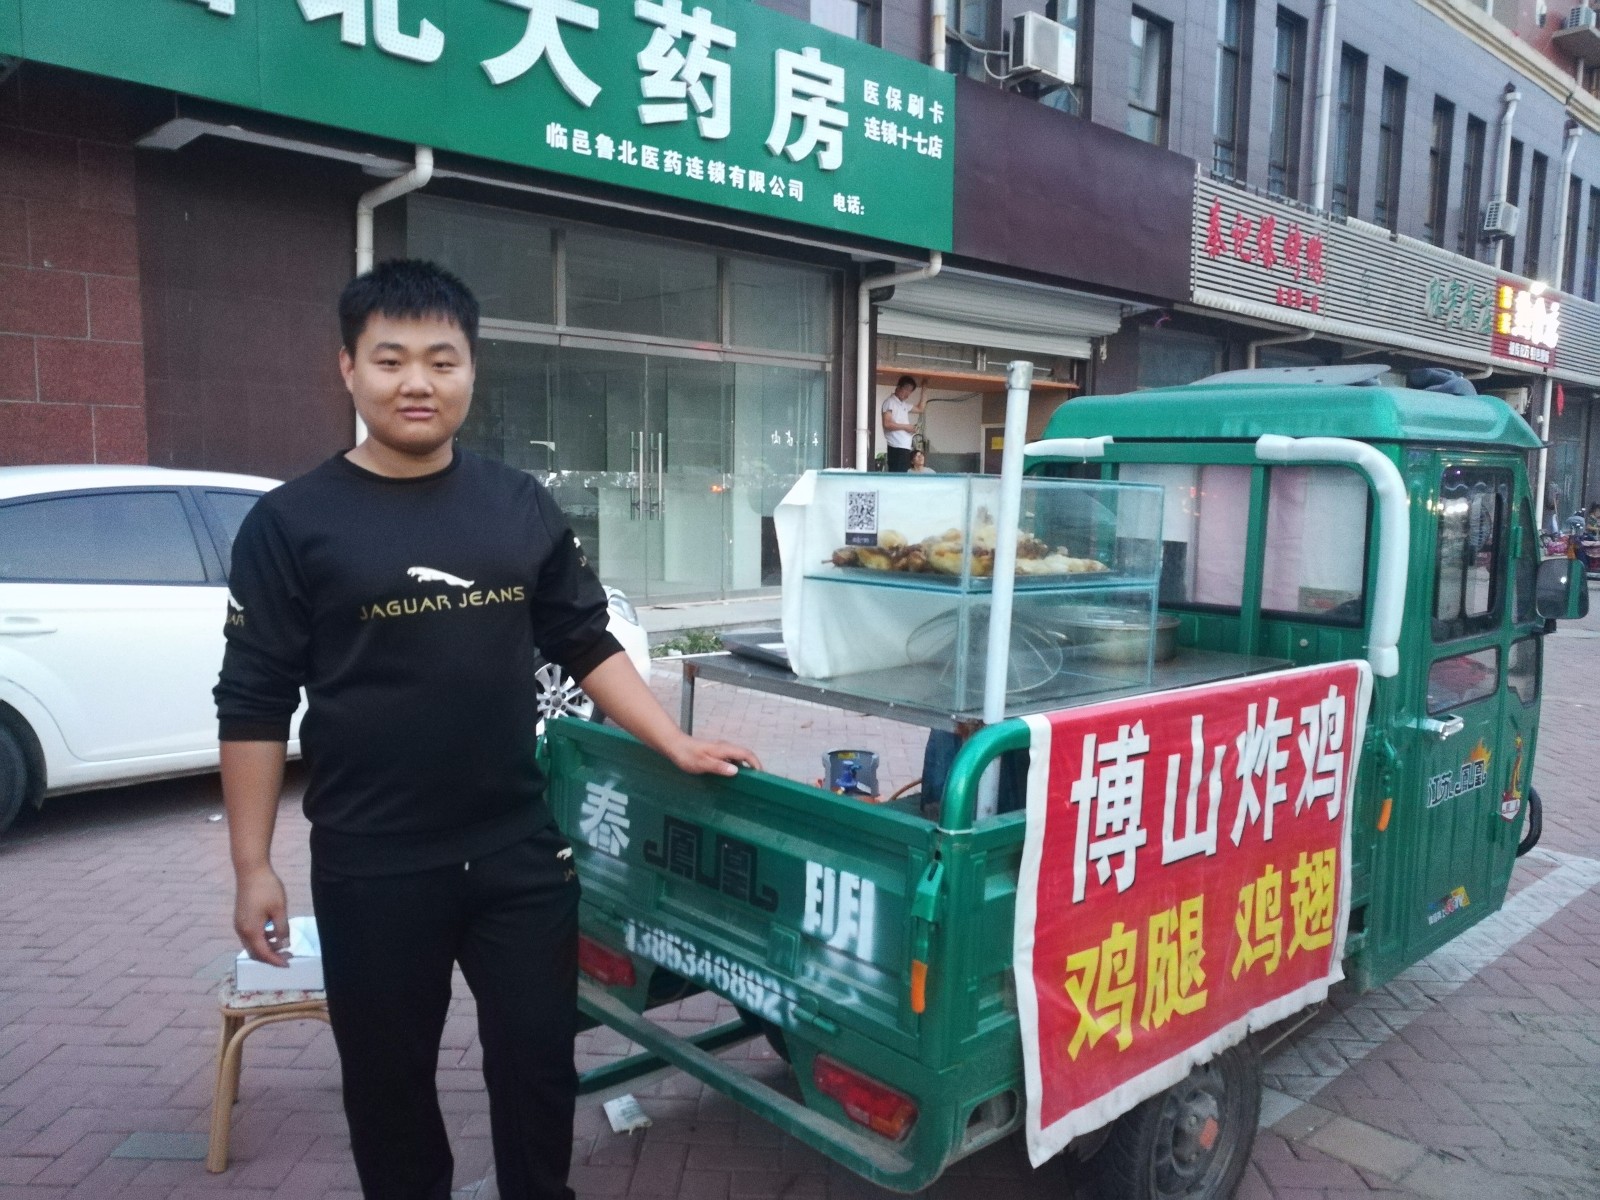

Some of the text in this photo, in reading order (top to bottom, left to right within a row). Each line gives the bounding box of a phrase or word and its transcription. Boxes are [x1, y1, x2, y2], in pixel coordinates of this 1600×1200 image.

[863, 79, 944, 124] 医保刷卡
[863, 116, 943, 160] 连锁十七店
[546, 122, 804, 202] 临邑鲁北医药连锁有限公司
[360, 586, 525, 621] JAGUAR JEANS
[1069, 684, 1347, 903] 博山炸鸡
[801, 859, 878, 963] 明
[1063, 847, 1338, 1061] 鸡腿 鸡翅
